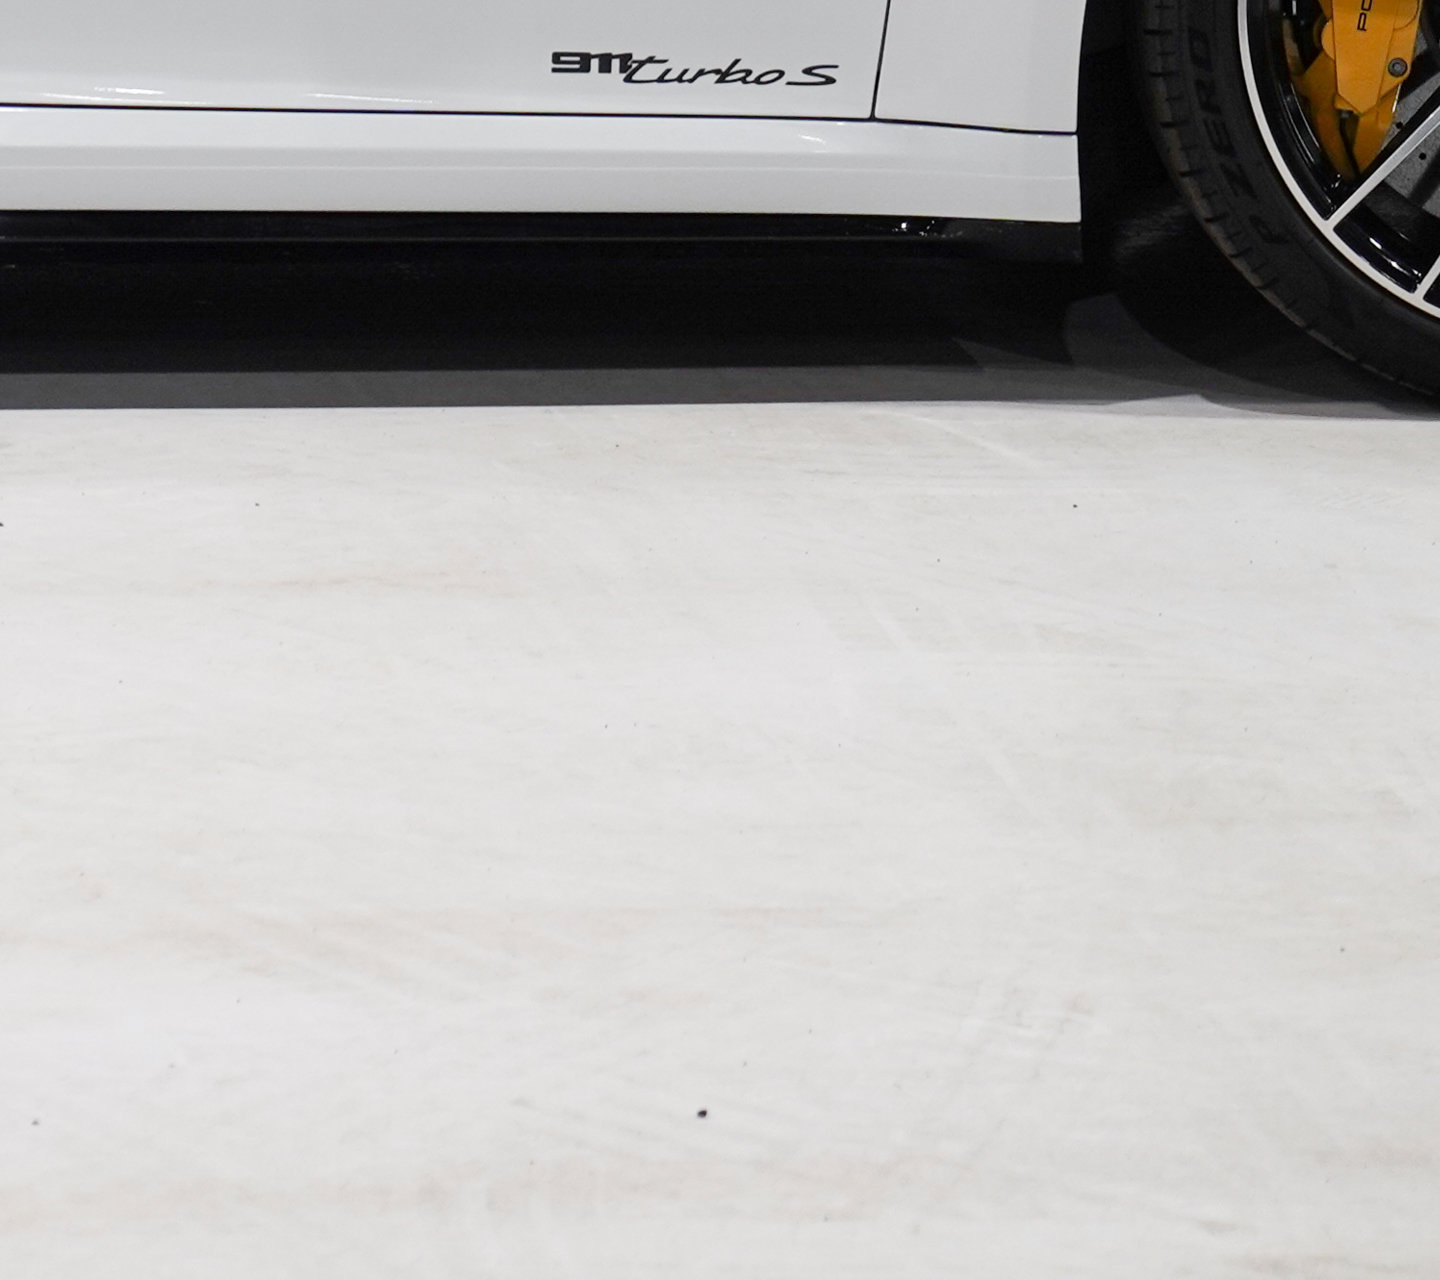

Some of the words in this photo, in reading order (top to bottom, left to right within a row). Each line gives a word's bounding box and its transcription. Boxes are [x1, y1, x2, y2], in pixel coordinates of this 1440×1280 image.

[551, 51, 633, 74] 911
[623, 55, 786, 85] turbo
[786, 64, 840, 87] S
[1187, 28, 1257, 201] ZERO
[1249, 213, 1289, 246] P
